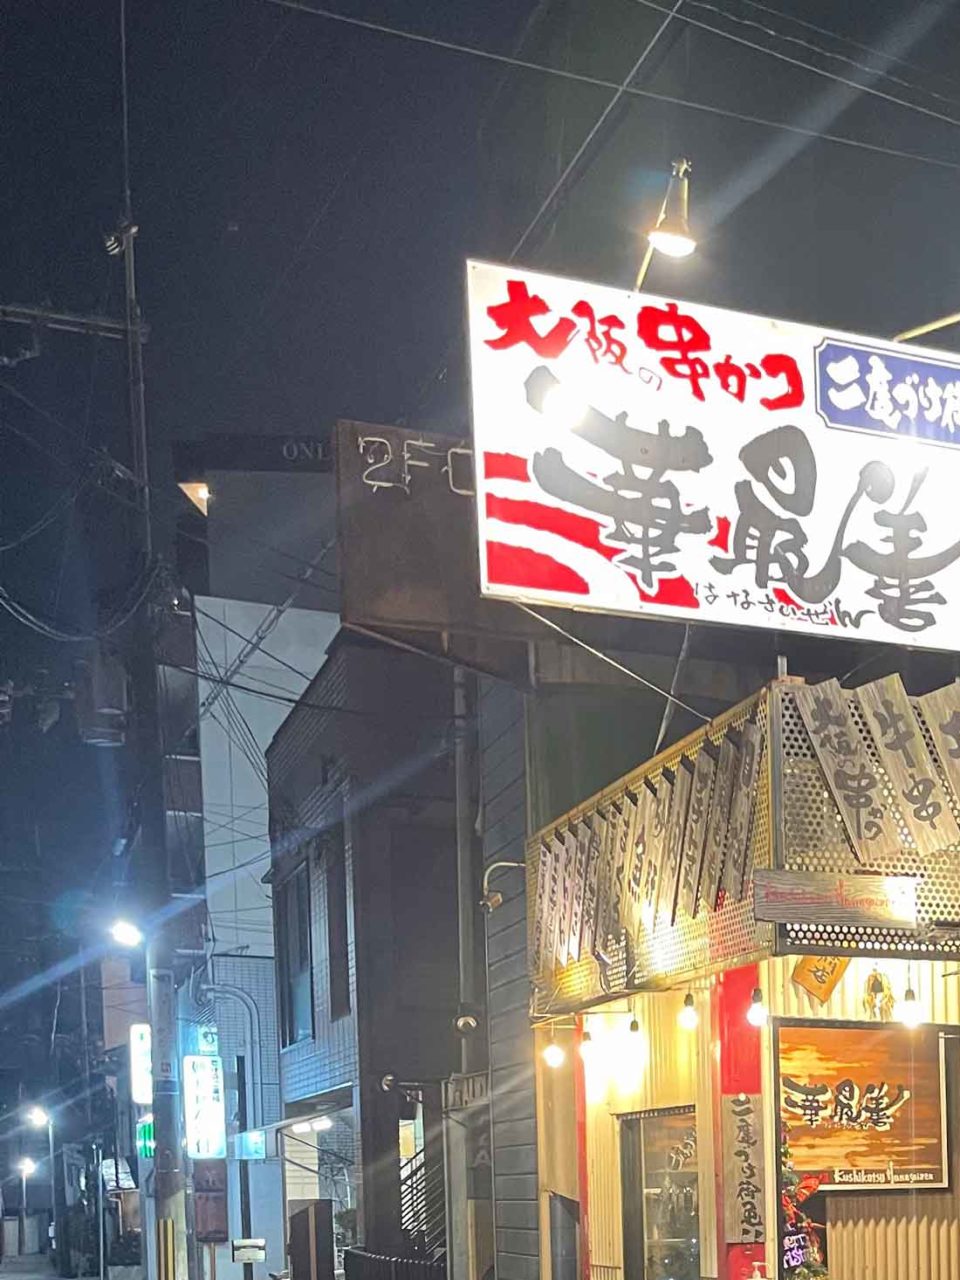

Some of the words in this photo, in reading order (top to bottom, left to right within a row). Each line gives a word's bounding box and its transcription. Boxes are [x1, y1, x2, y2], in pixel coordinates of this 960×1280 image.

[484, 281, 804, 410] 大阪の串かつ
